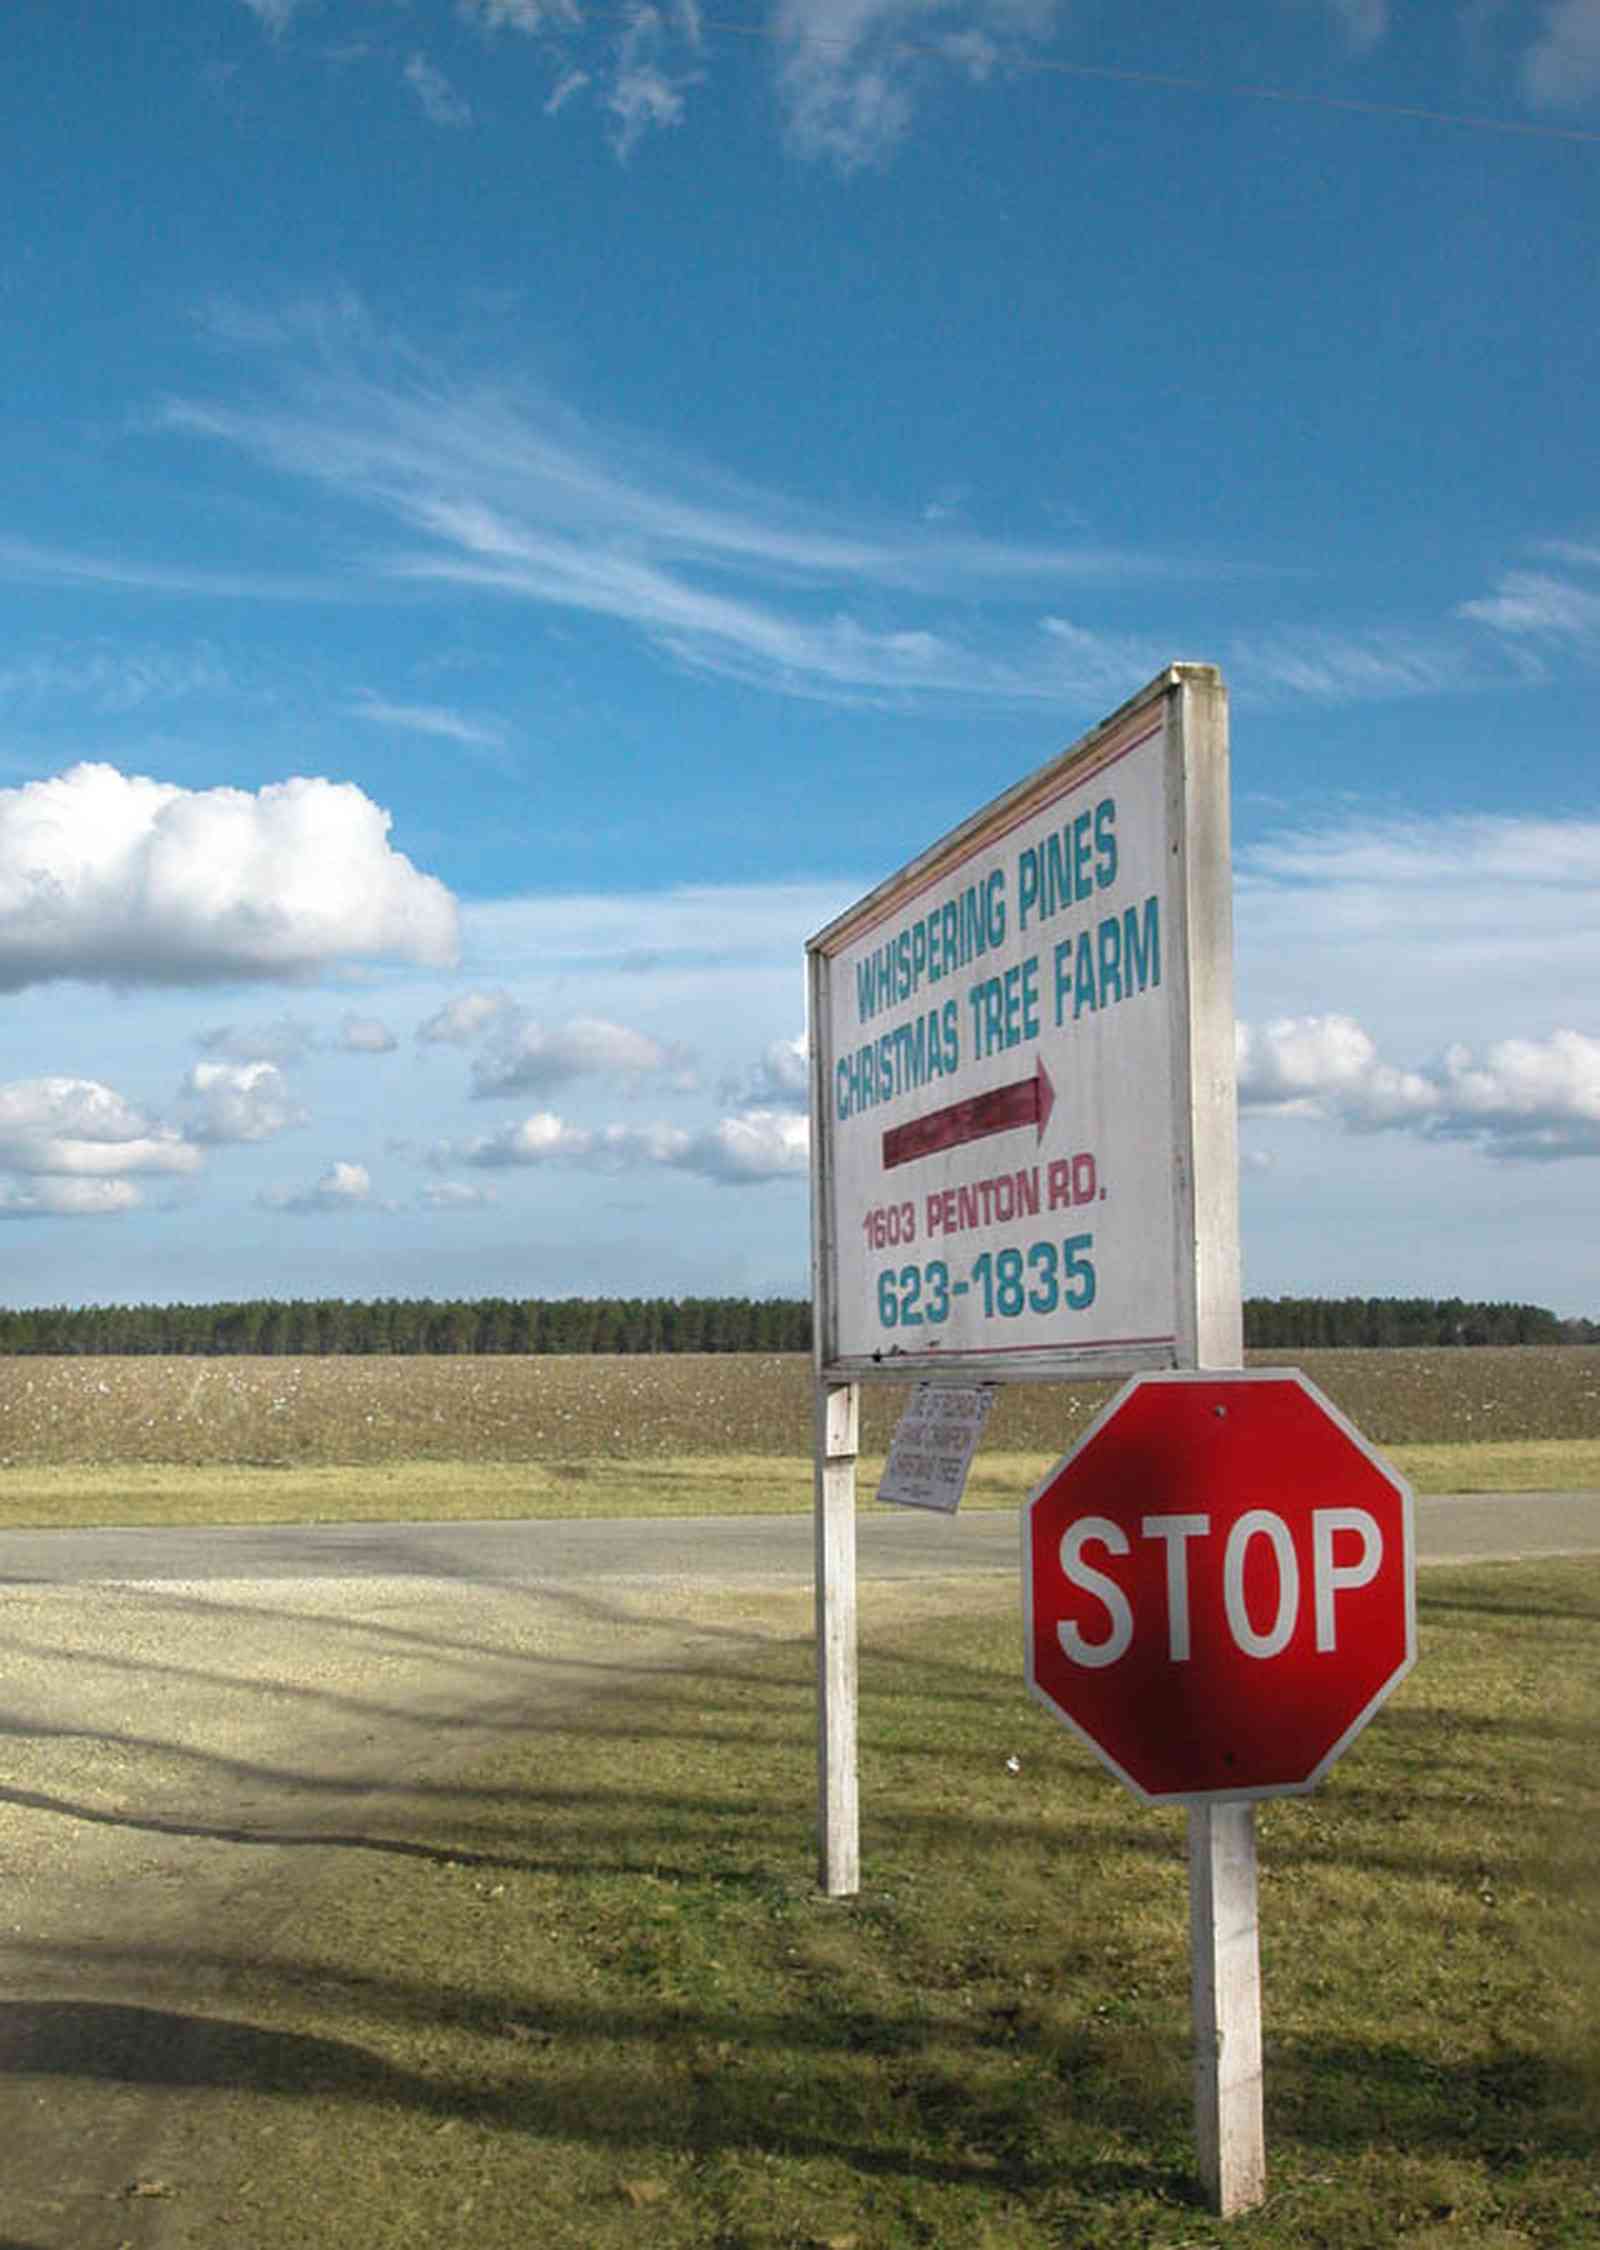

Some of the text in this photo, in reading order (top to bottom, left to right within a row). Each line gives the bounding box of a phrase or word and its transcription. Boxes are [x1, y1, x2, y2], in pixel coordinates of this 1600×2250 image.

[857, 798, 1117, 1023] WHISPERING PINES
[836, 897, 1161, 1120] CHRISTMAS TREE FARM
[863, 1152, 1106, 1250] 1603 PENTON RD.
[878, 1232, 1095, 1328] 623-1835
[1056, 1507, 1384, 1668] STOP
